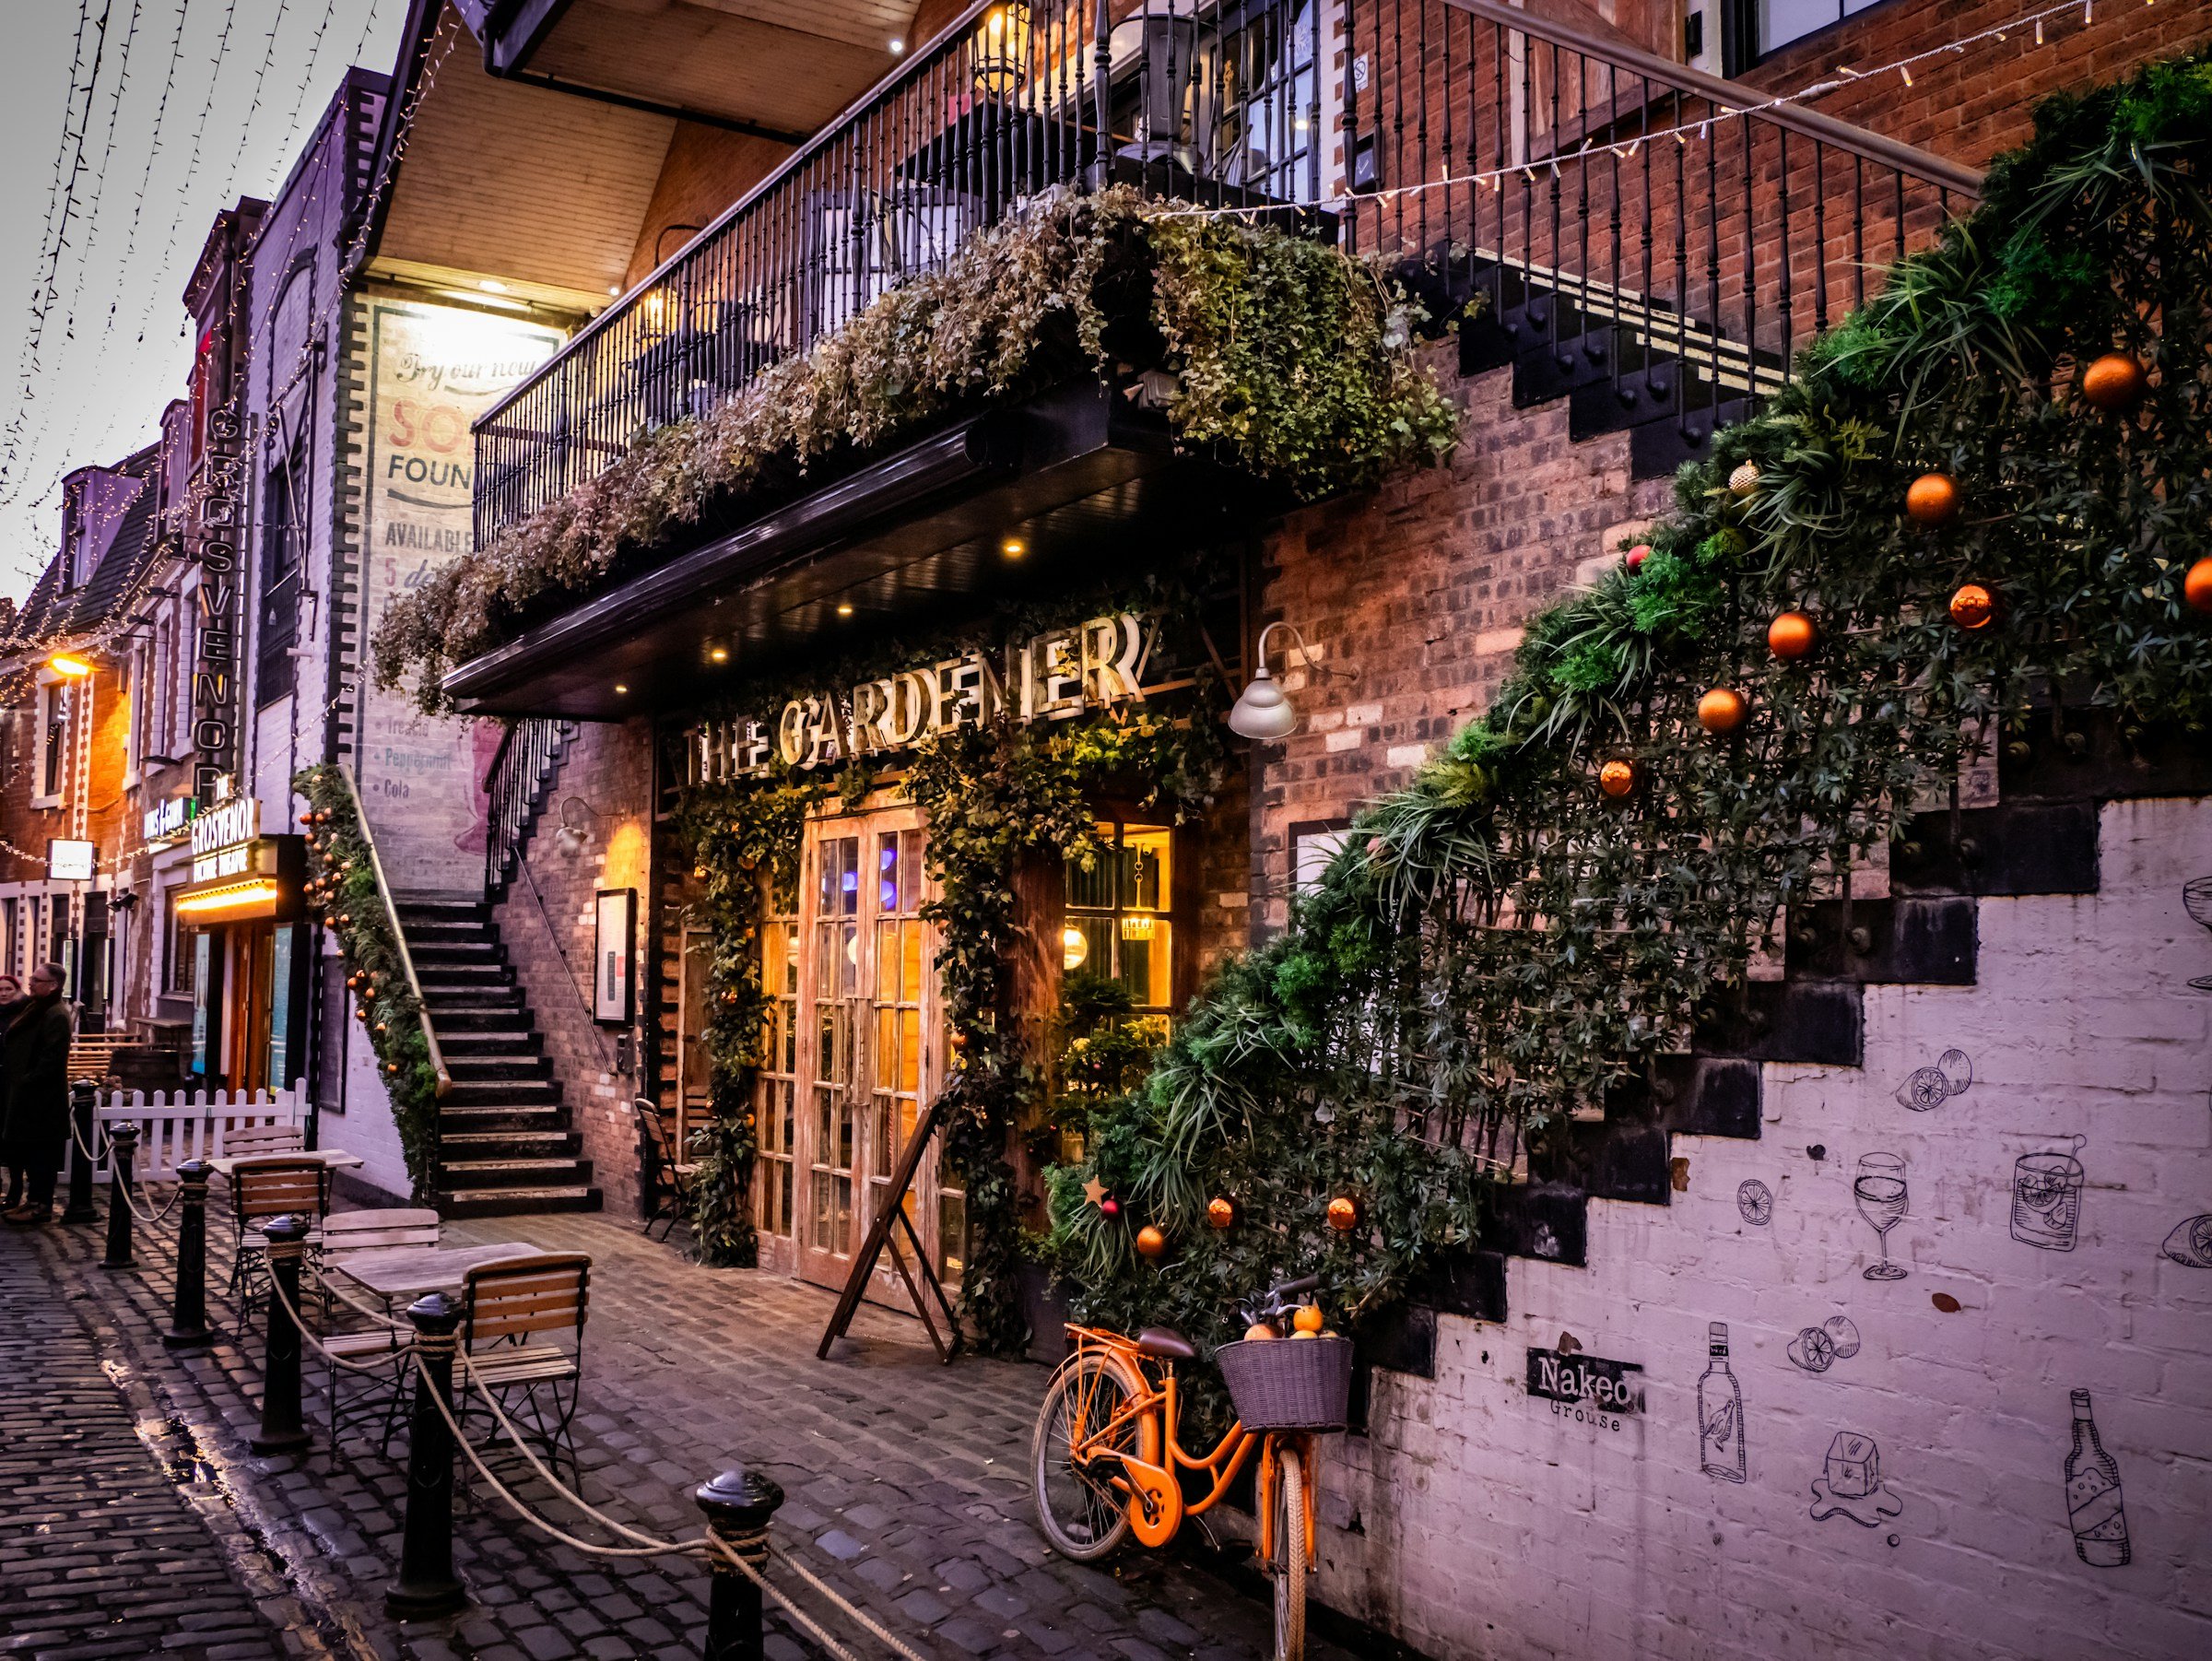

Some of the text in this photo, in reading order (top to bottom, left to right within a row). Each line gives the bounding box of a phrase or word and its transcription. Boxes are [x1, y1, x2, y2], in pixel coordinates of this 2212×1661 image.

[395, 352, 536, 391] Try our new
[385, 399, 474, 456] SO
[385, 522, 473, 553] AVAILABLE
[383, 557, 396, 587] 5
[683, 614, 1145, 785] THE GARDENER
[384, 778, 409, 798] Cola
[191, 797, 254, 855] GROSVENOR
[1550, 1399, 1621, 1431] Grouse
